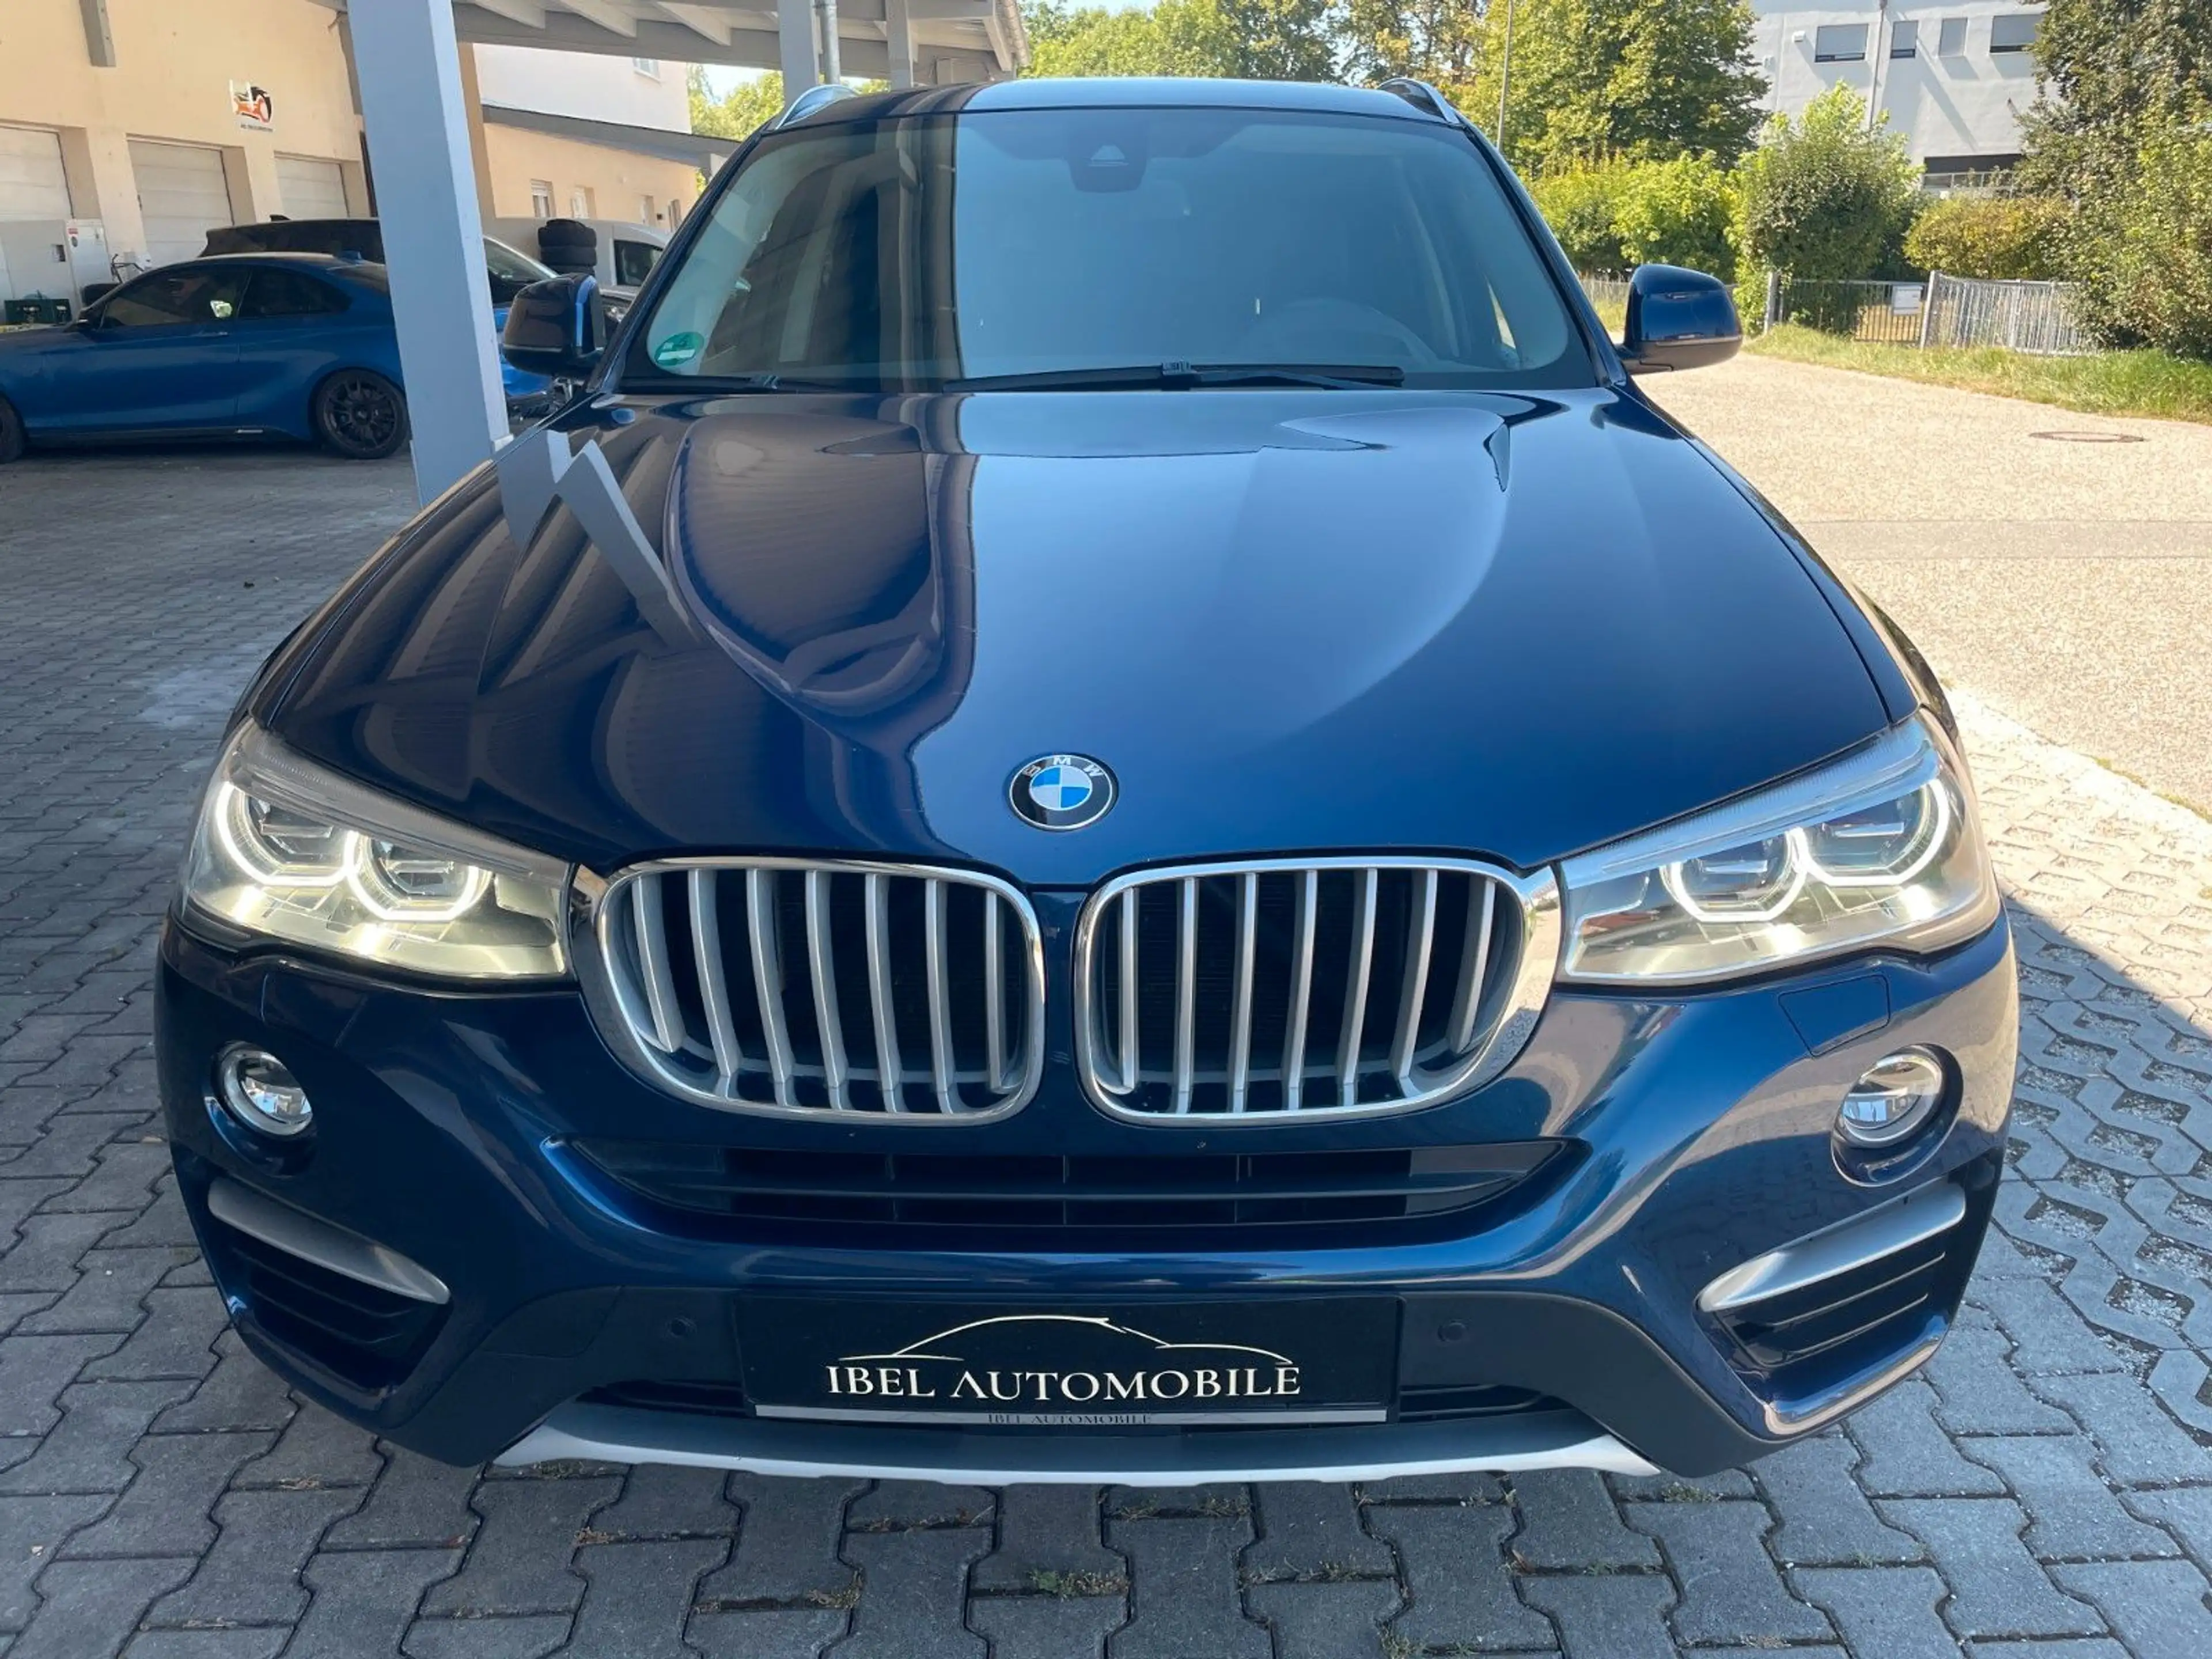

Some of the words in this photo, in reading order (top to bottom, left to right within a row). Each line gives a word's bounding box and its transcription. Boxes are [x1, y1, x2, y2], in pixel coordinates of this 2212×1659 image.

[1022, 756, 1104, 778] BMW
[826, 1366, 935, 1397] IBEL
[950, 1367, 1301, 1401] AUTOMOBILE
[988, 1414, 1025, 1424] IBEL
[1030, 1415, 1152, 1424] AUTOMOBILE
